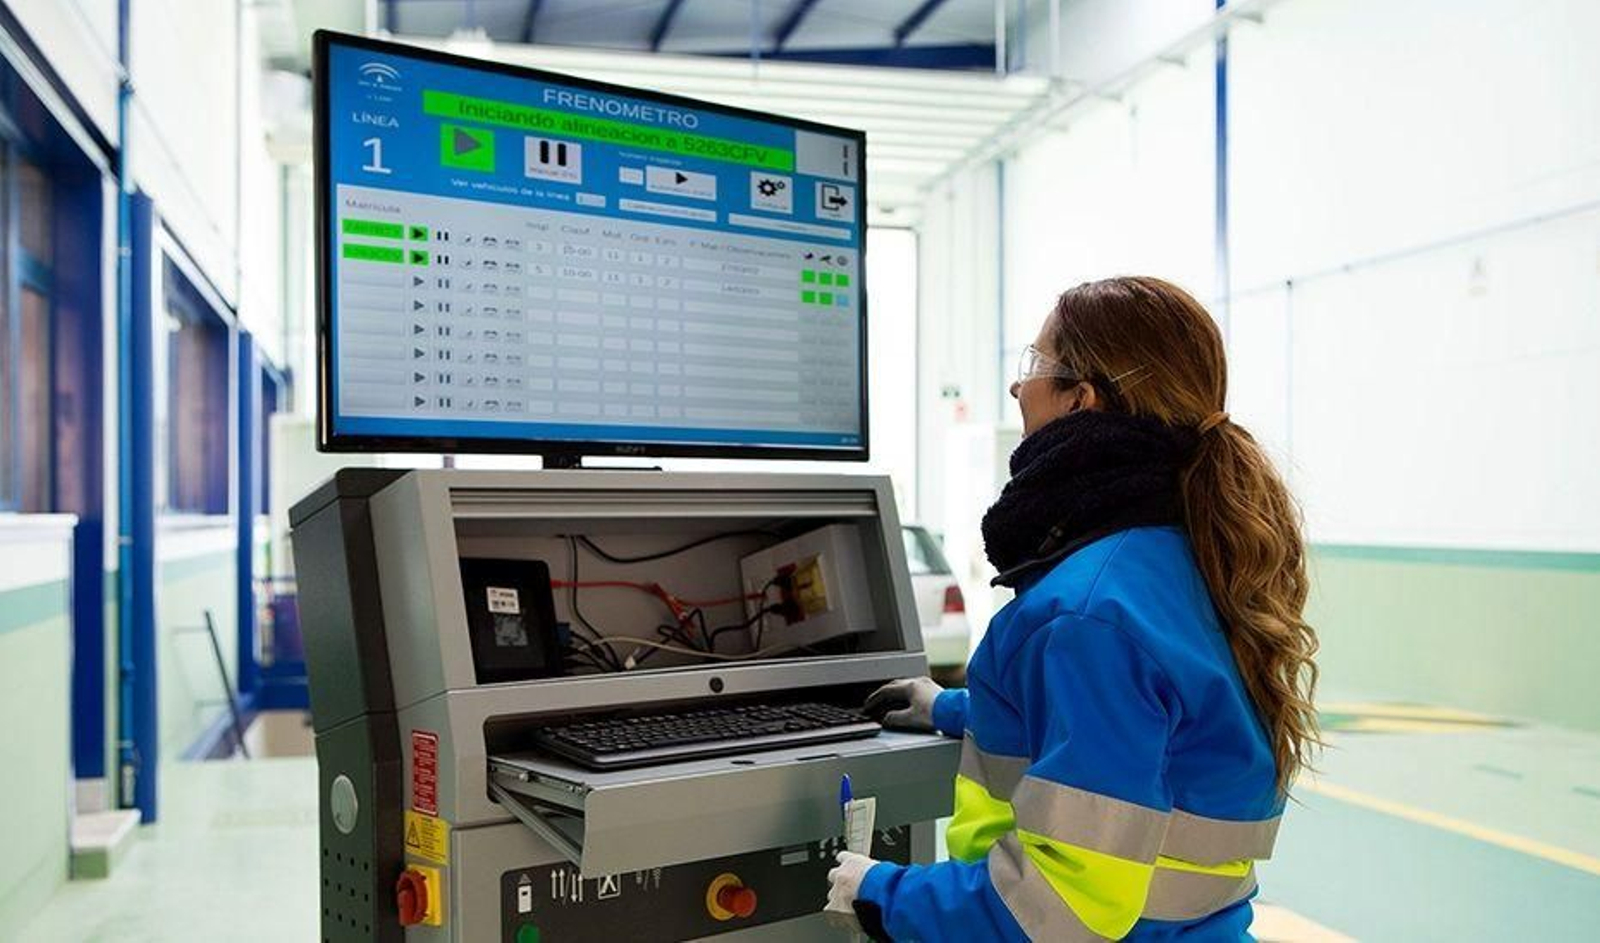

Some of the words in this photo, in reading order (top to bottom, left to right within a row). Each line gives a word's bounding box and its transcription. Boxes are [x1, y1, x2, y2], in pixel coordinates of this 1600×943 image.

[352, 111, 400, 128] LÍNEA
[458, 99, 554, 129] Iniciando
[562, 117, 661, 146] alineacion
[665, 138, 677, 150] a
[542, 87, 699, 129] FRENOMETRO
[362, 136, 393, 175] 1
